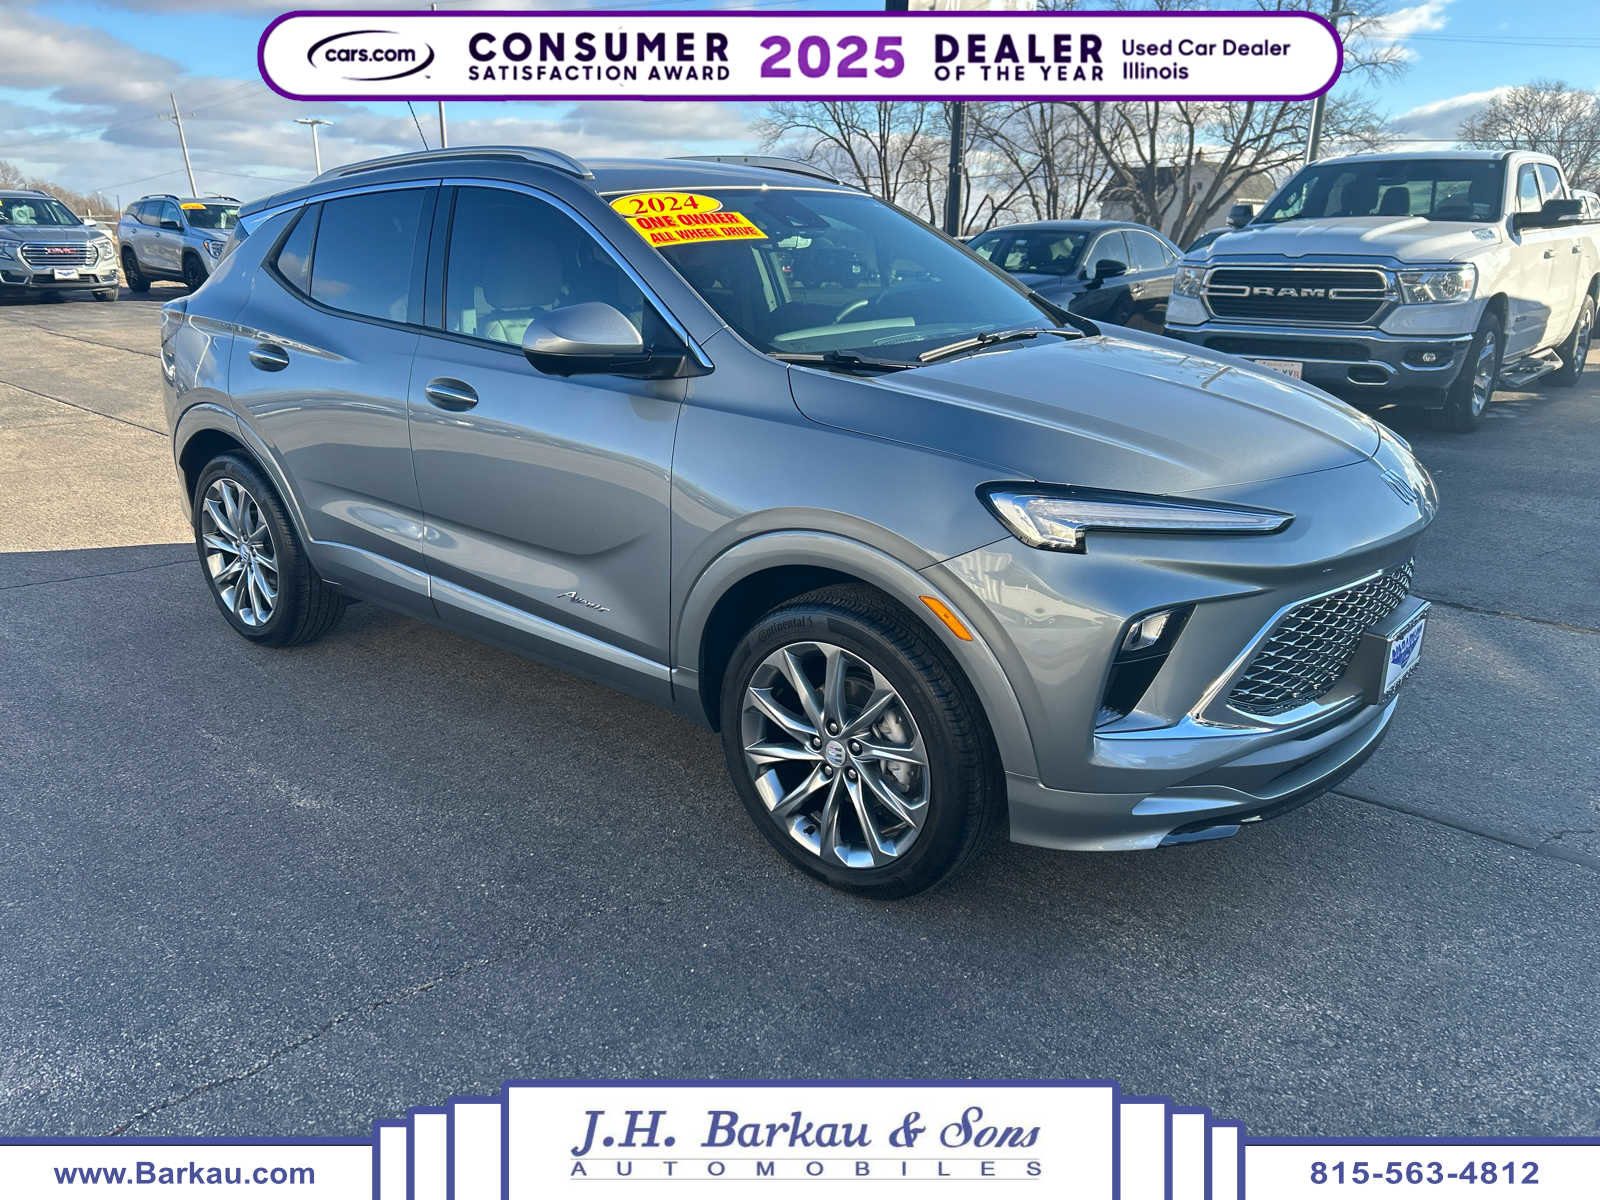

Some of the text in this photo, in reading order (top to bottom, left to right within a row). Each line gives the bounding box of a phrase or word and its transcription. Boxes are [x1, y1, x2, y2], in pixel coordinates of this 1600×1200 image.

[630, 196, 699, 214] 2024
[636, 212, 740, 231] ONE OWNER
[650, 226, 760, 245] ALL WHEEL DRIVE
[1252, 286, 1326, 298] RAM
